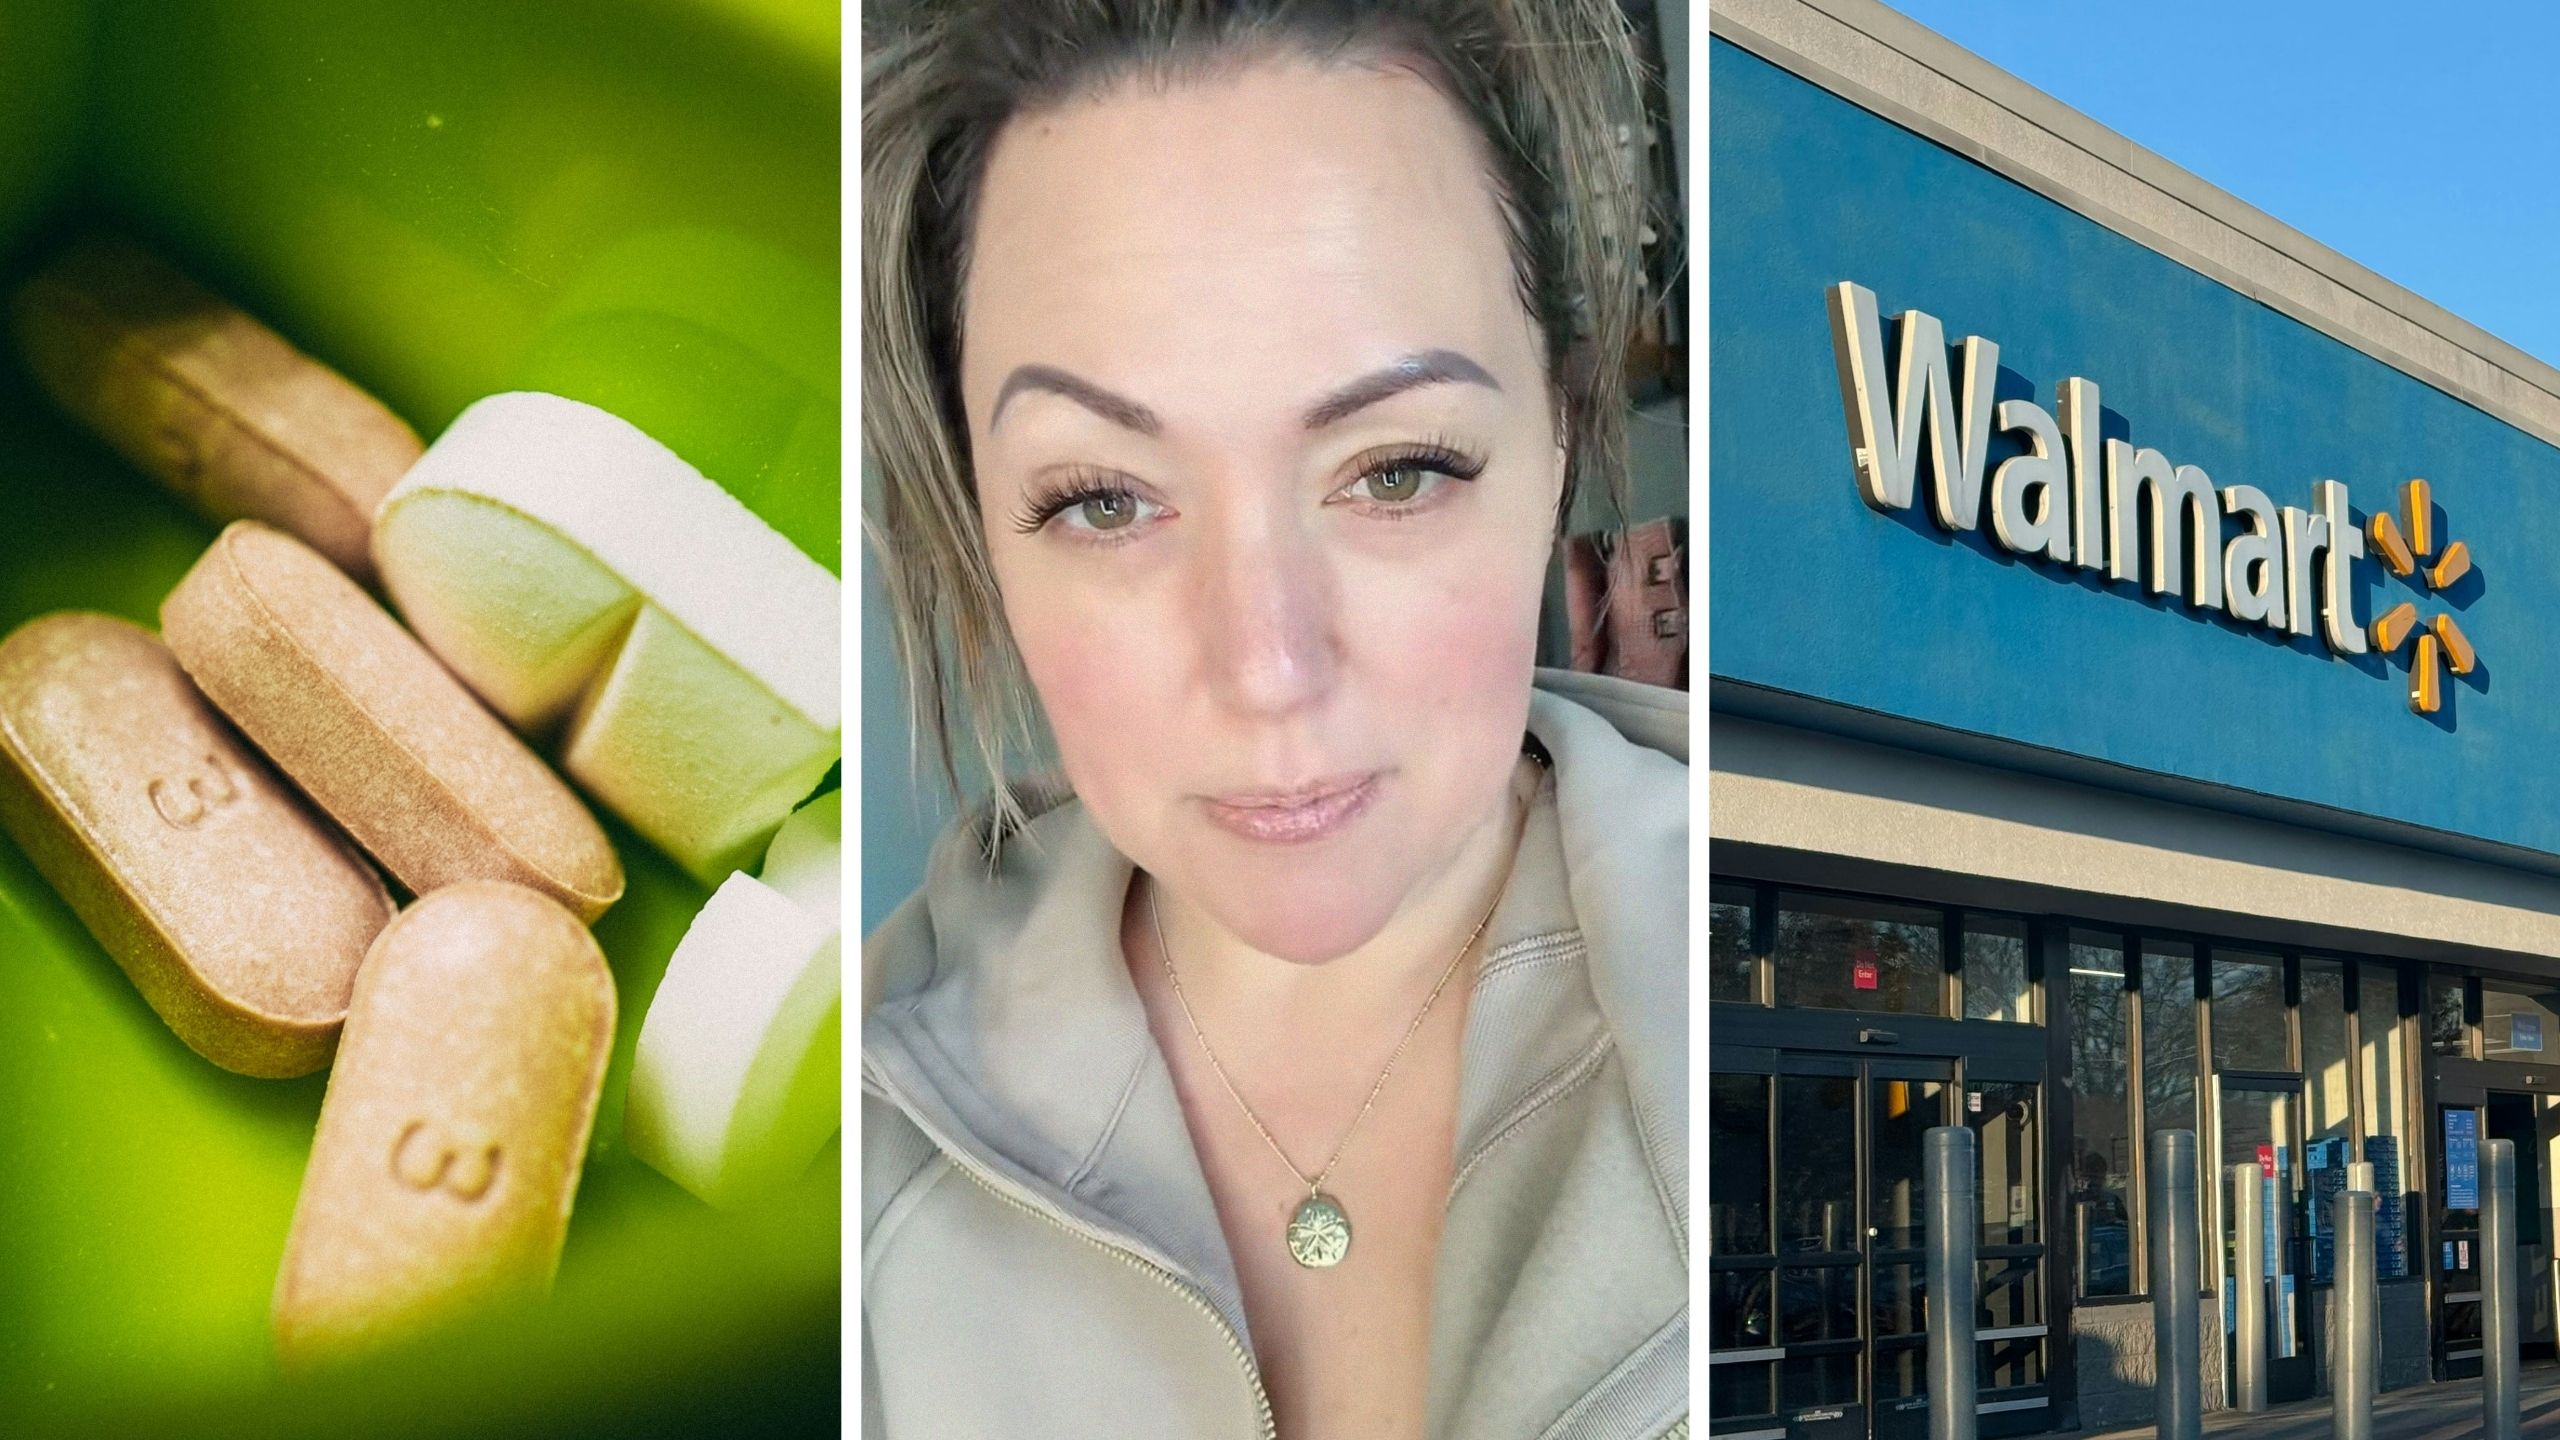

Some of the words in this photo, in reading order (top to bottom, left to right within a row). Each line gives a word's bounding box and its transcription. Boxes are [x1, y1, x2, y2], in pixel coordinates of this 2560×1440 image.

[1827, 280, 2366, 657] Walmart
[147, 754, 241, 831] 3
[1858, 969, 1873, 979] Enter
[389, 1117, 502, 1203] 3
